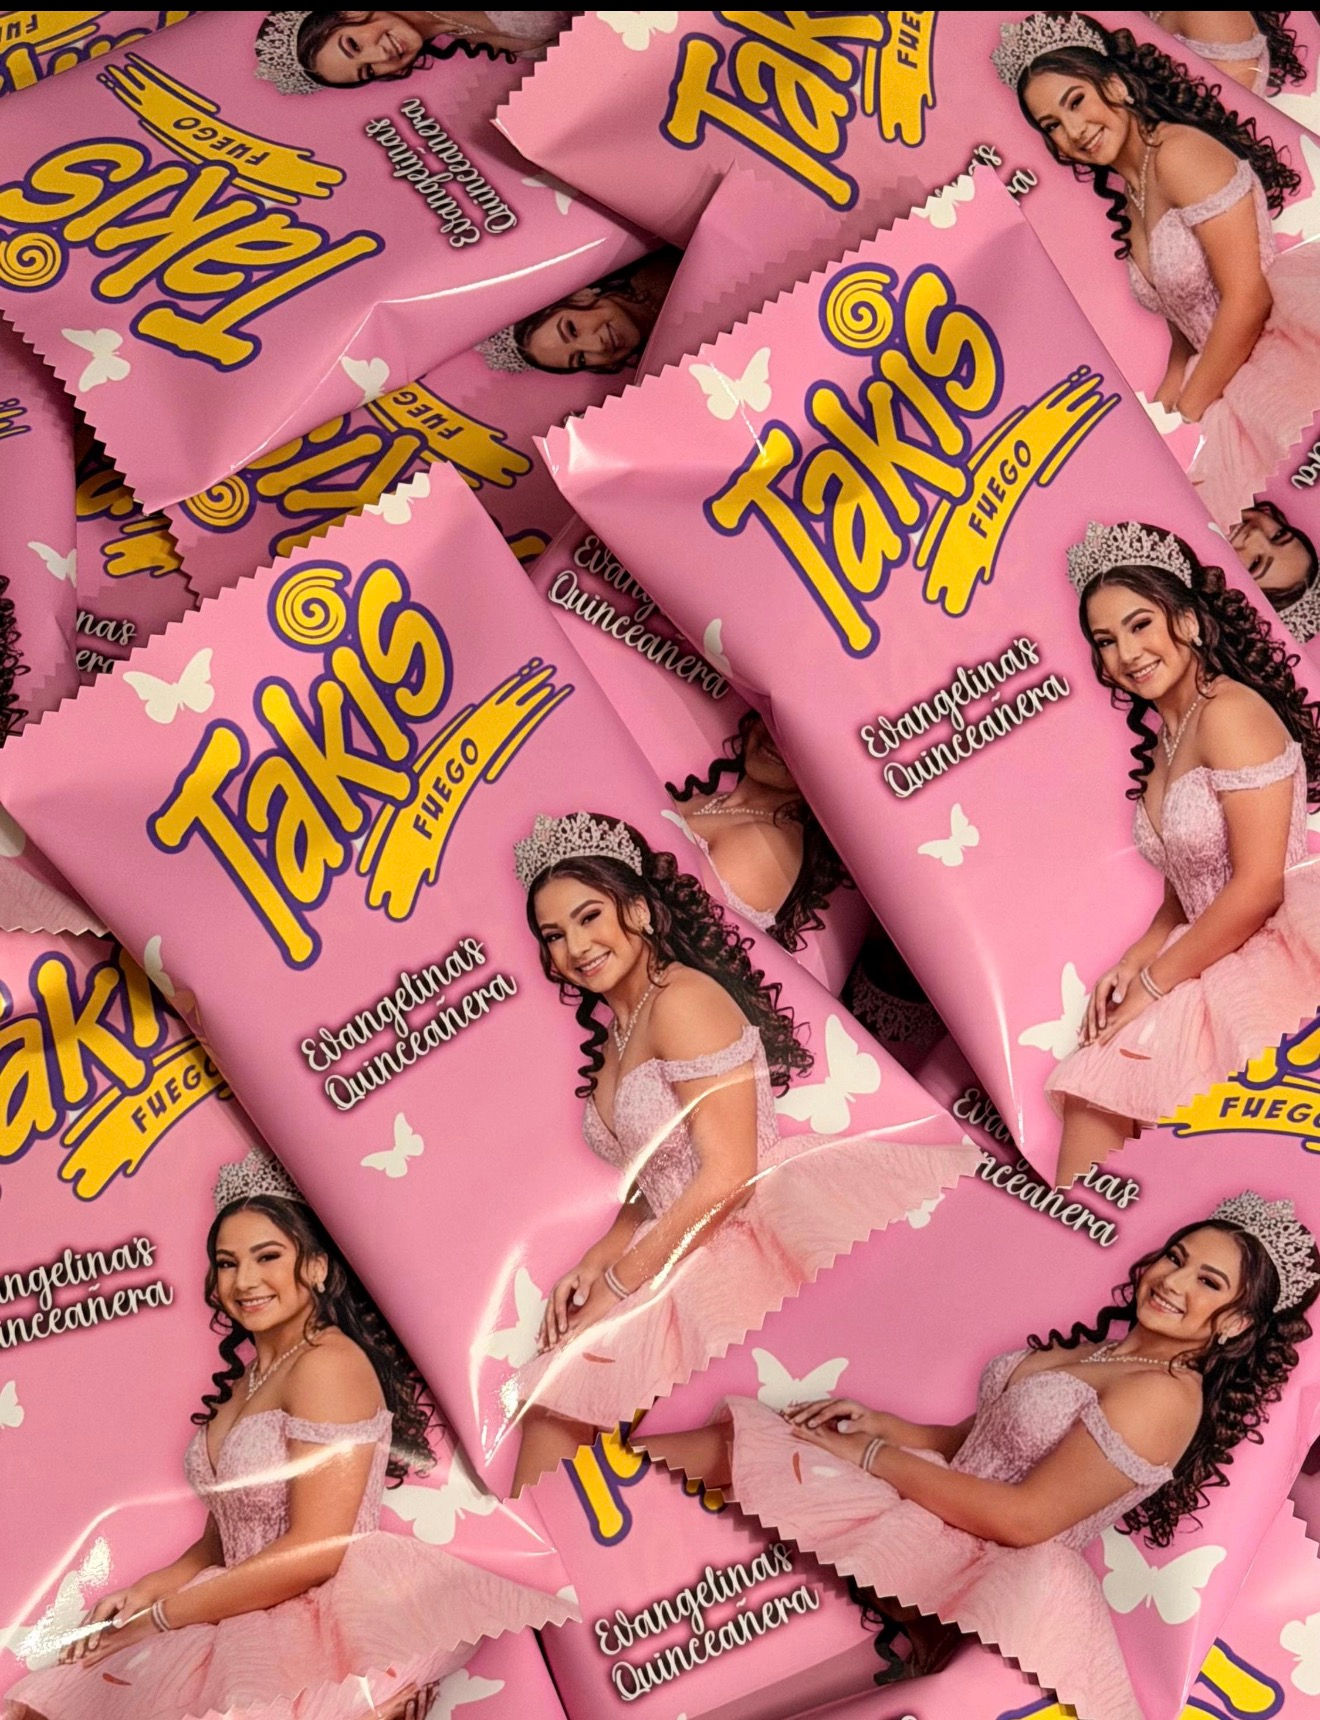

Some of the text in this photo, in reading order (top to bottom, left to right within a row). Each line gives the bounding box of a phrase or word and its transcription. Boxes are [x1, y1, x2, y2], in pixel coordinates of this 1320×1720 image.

[173, 117, 271, 166] FUEGO
[365, 118, 481, 248] Evangelina's
[400, 98, 518, 234] Quinceañera
[392, 391, 465, 440] FUEG
[969, 440, 1032, 538] FUEGO
[861, 637, 1040, 758] Evangelina's
[883, 674, 1071, 798] Quinceañera
[413, 737, 481, 840] FUEGO
[301, 937, 486, 1071] Evangelina's
[325, 973, 518, 1111] Quinceañera
[0, 1237, 158, 1311] ngelina's
[594, 1542, 794, 1656] Evangelina's
[611, 1584, 820, 1702] Quinceañera
